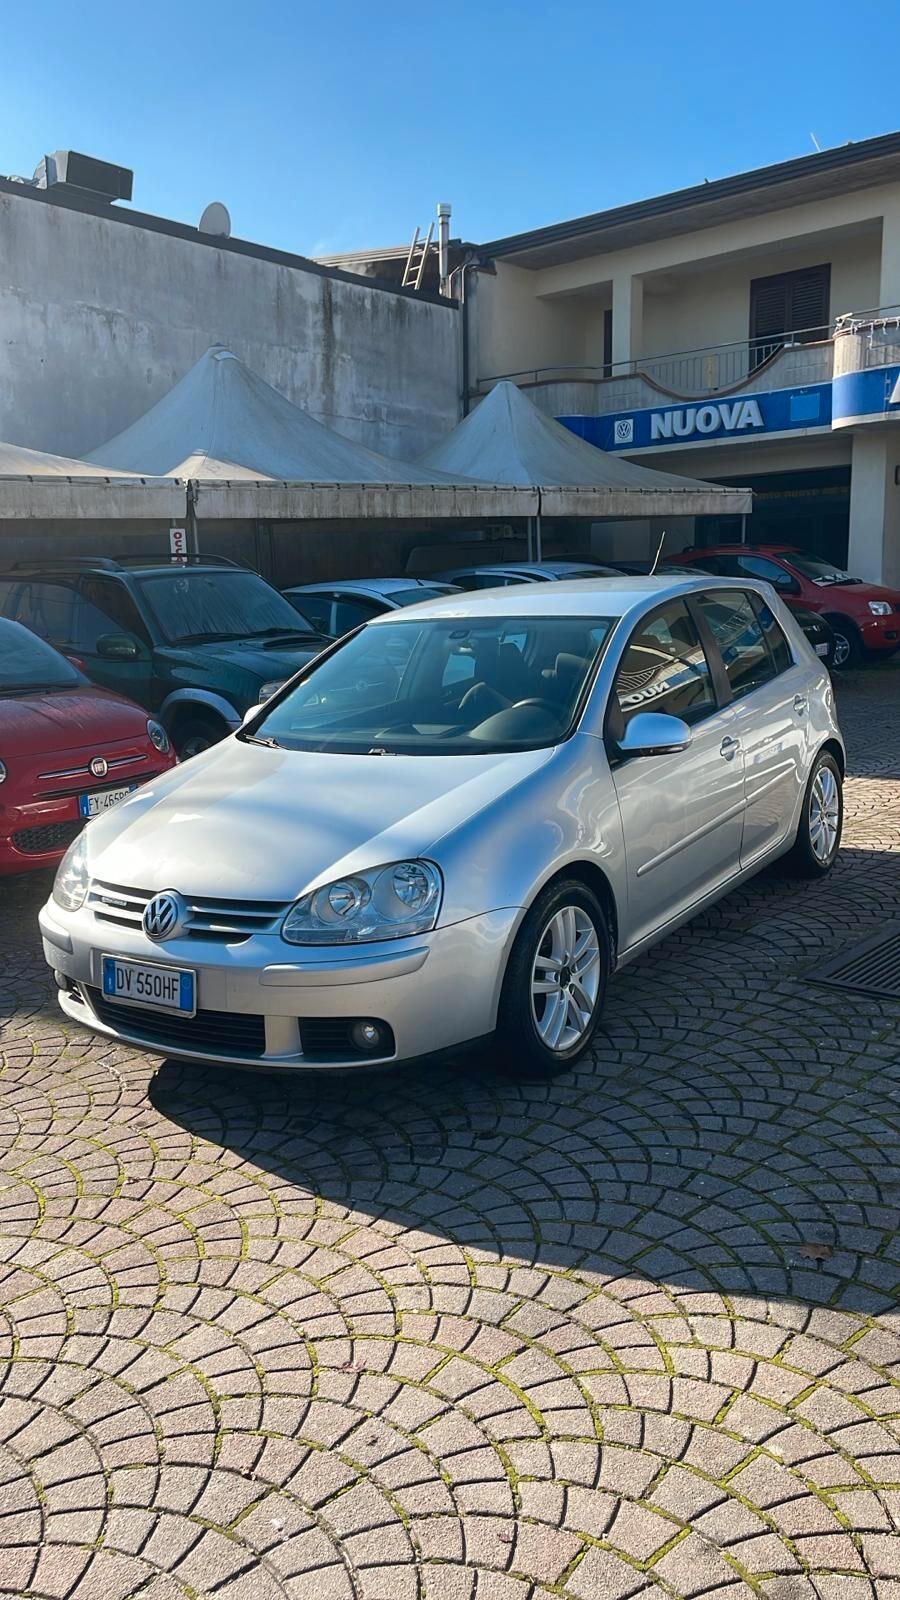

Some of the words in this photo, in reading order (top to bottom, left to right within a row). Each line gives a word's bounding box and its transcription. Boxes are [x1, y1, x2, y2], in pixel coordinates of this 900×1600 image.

[651, 400, 764, 440] NUOVA
[116, 968, 132, 991] DV
[136, 972, 179, 1001] 550HF
